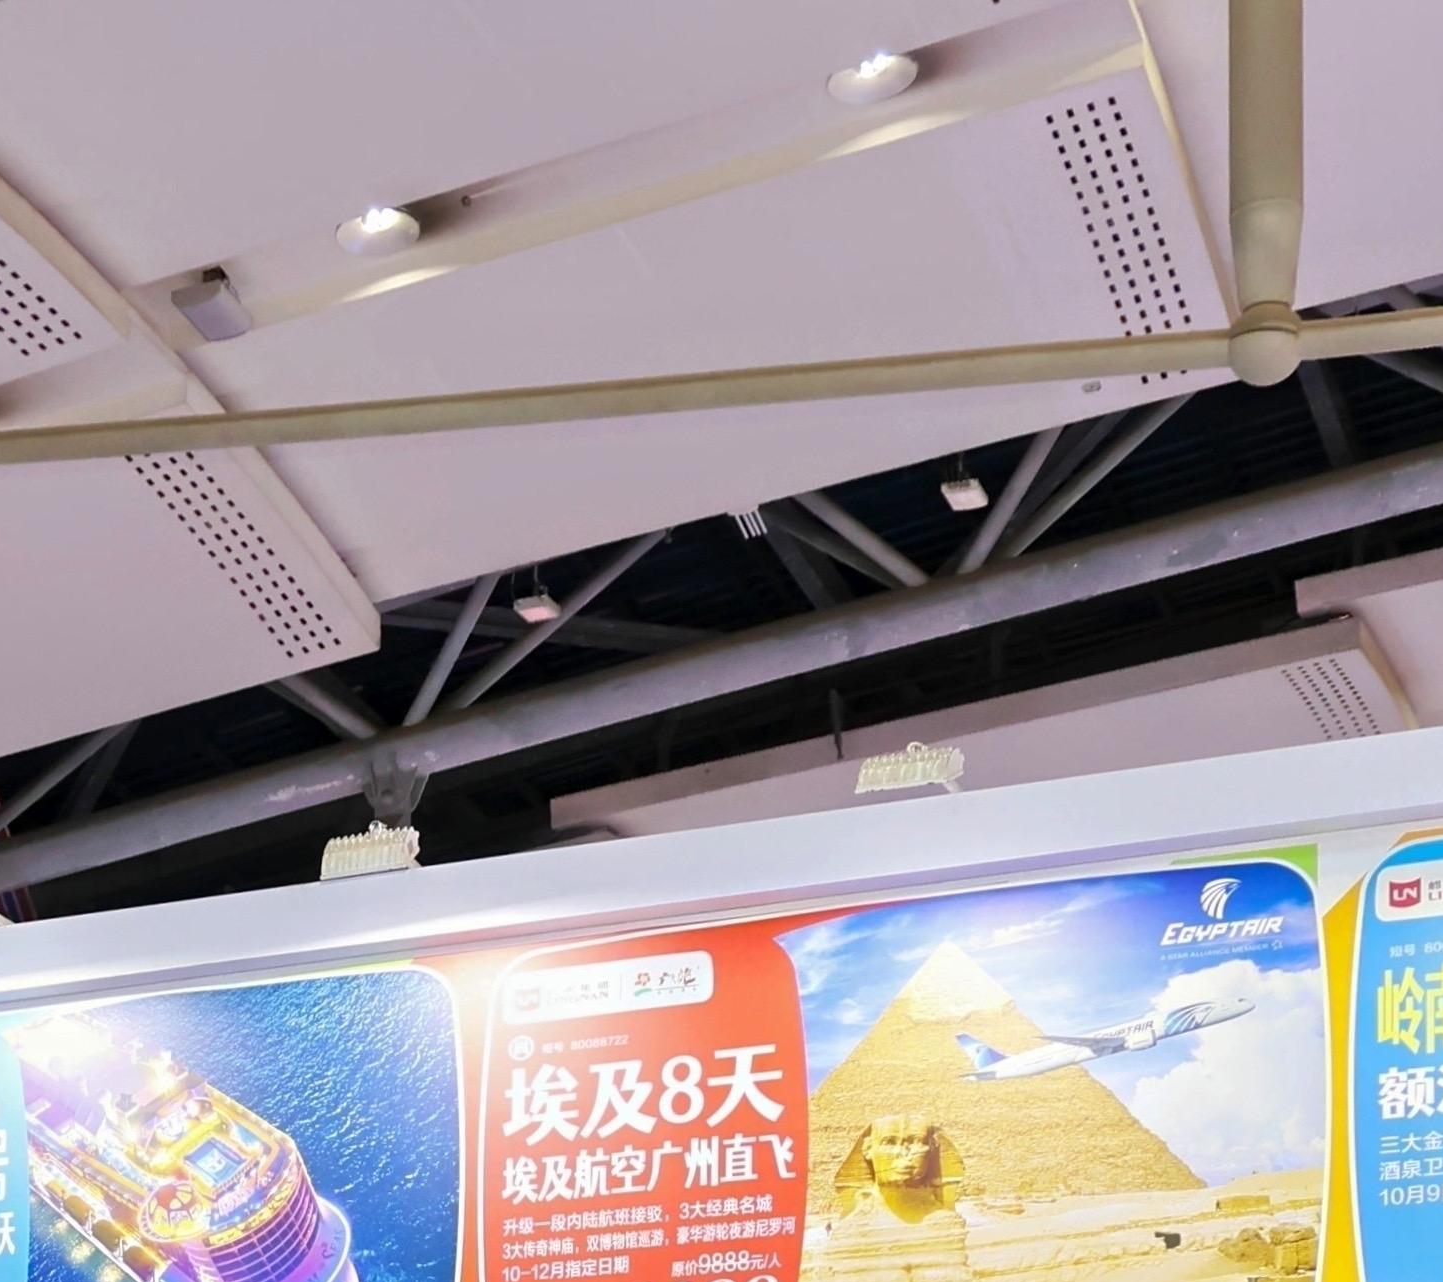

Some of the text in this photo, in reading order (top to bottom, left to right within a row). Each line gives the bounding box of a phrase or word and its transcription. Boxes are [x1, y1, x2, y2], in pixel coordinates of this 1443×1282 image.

[1160, 915, 1285, 946] EGYPTAIR
[570, 1033, 628, 1052] 80088722
[503, 1044, 786, 1145] 埃及8天
[502, 1133, 796, 1203] 埃及航空广州直飞
[671, 1249, 782, 1276] 原价9888元/人
